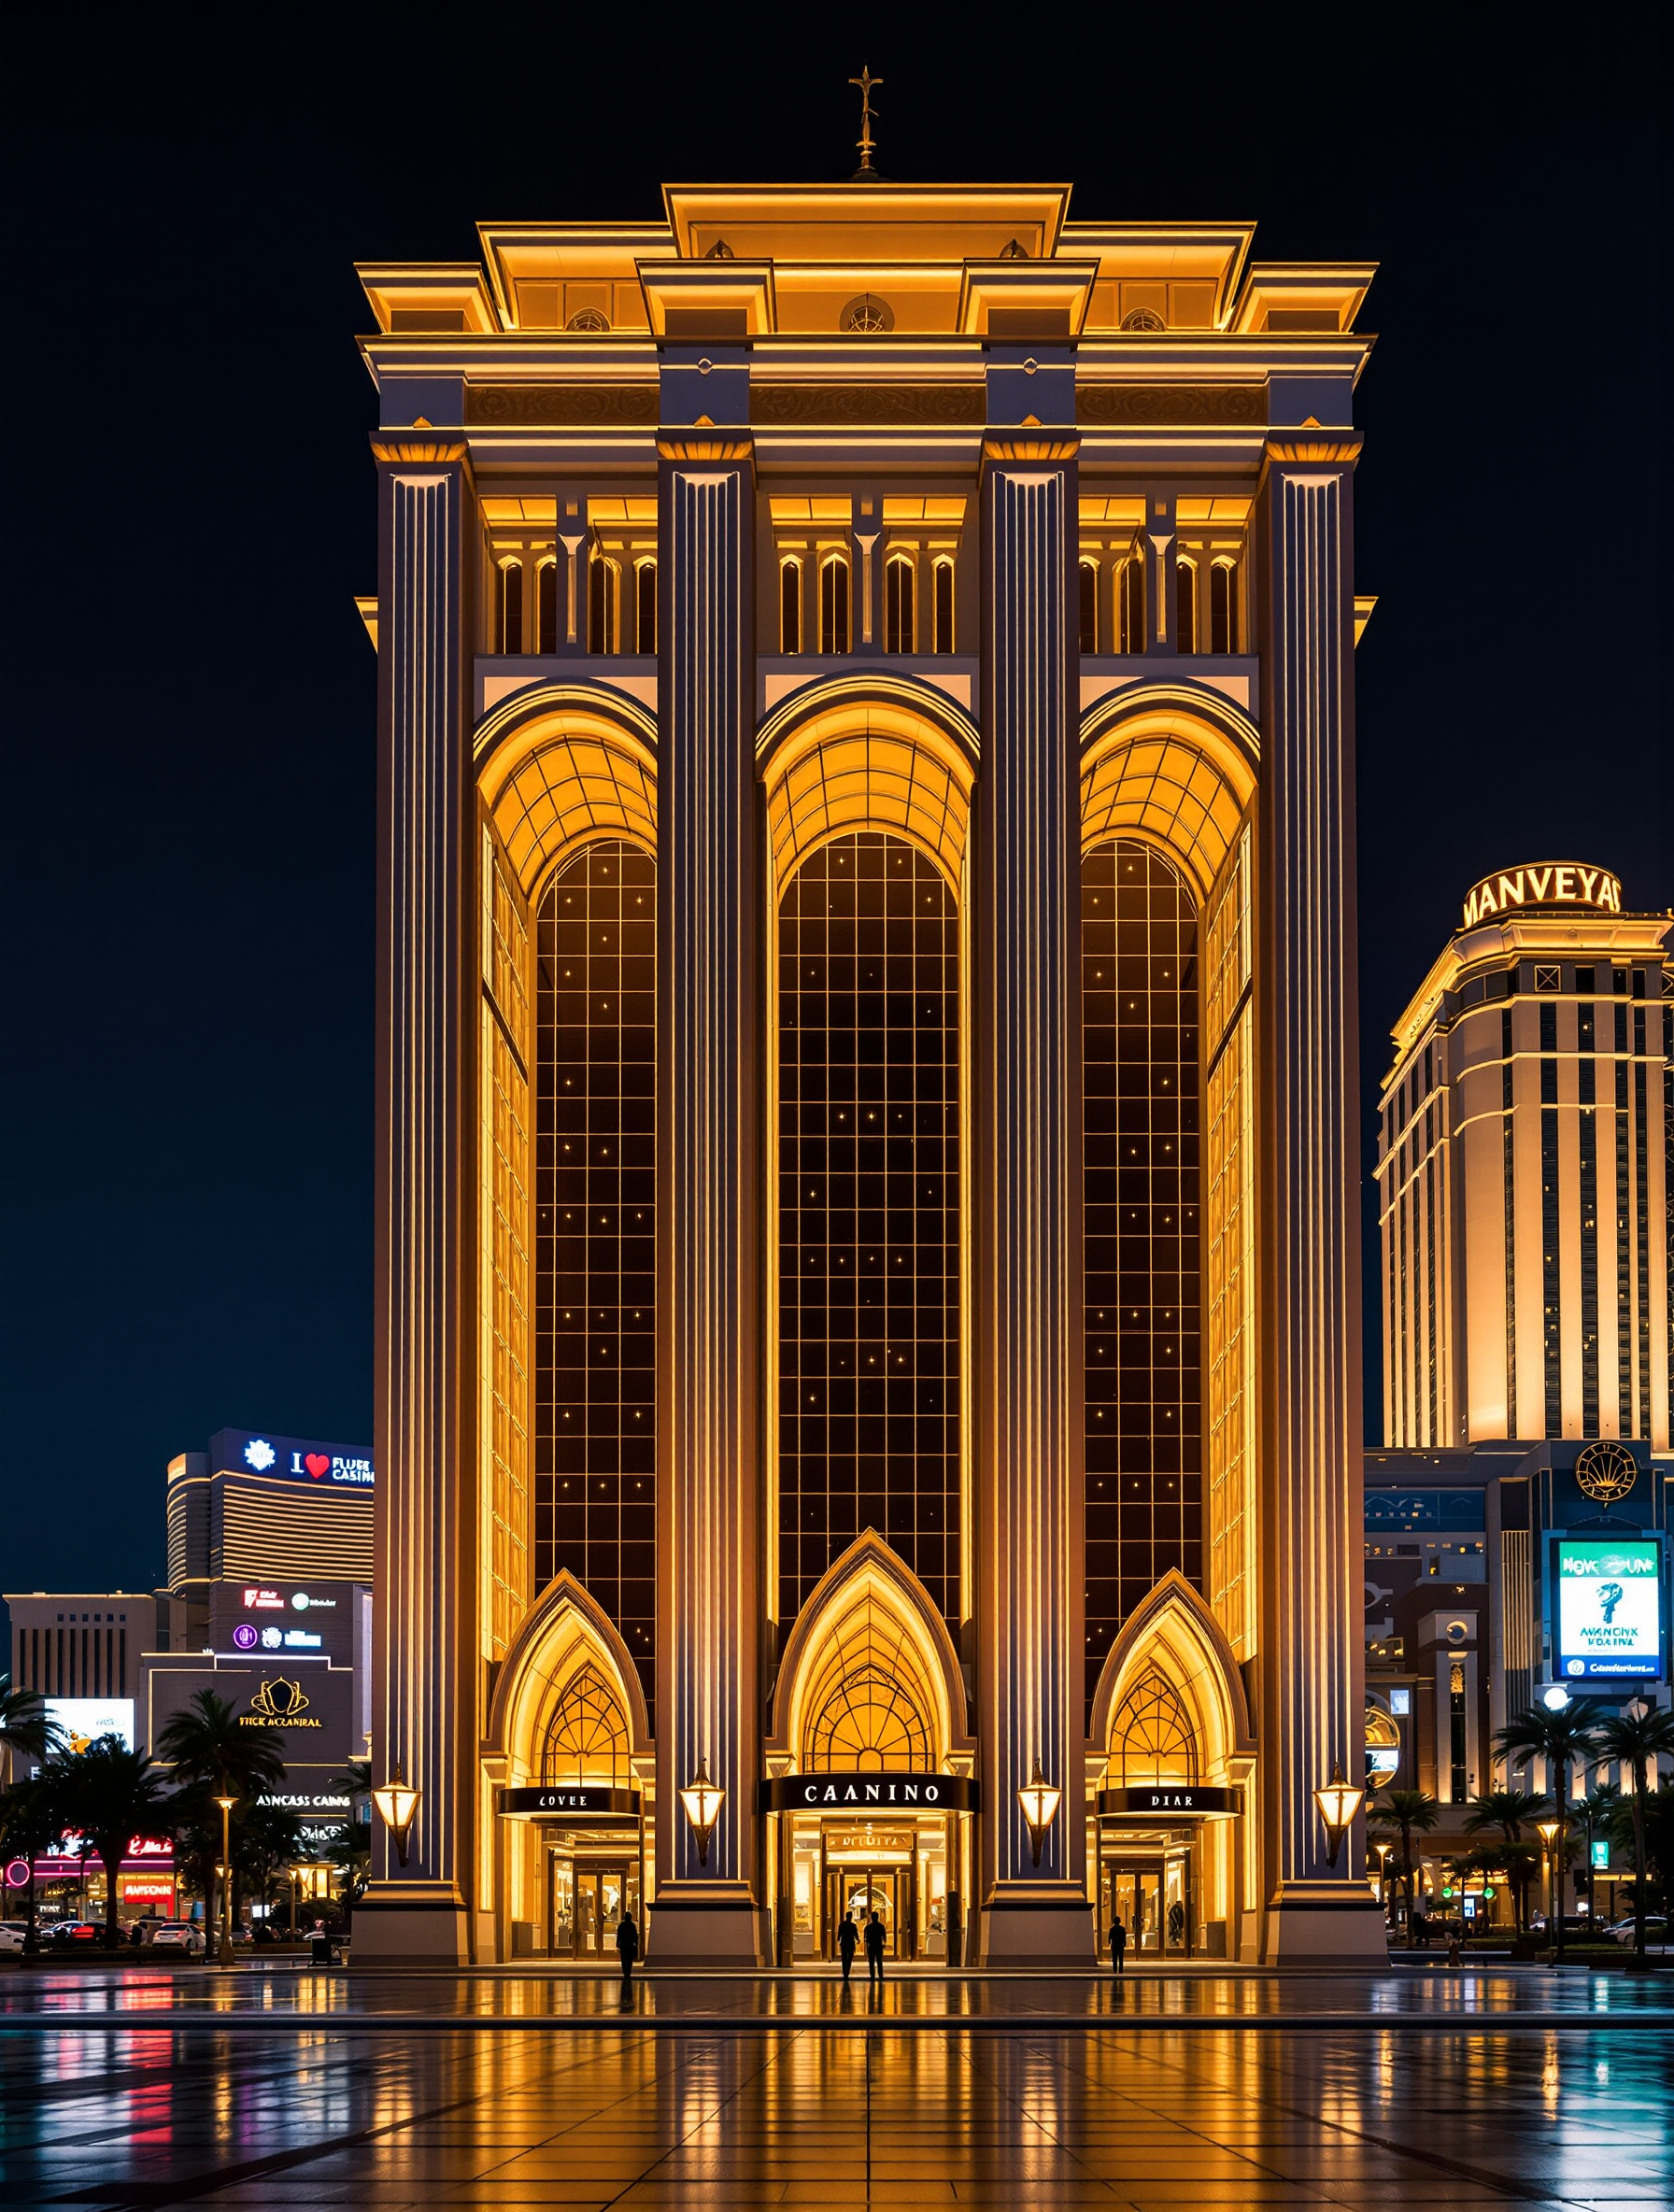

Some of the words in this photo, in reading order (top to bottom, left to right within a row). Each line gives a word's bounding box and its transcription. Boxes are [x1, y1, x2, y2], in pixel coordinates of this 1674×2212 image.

[291, 1453, 305, 1473] I
[804, 1784, 939, 1802] CAANINO
[1151, 1795, 1193, 1807] DIAR
